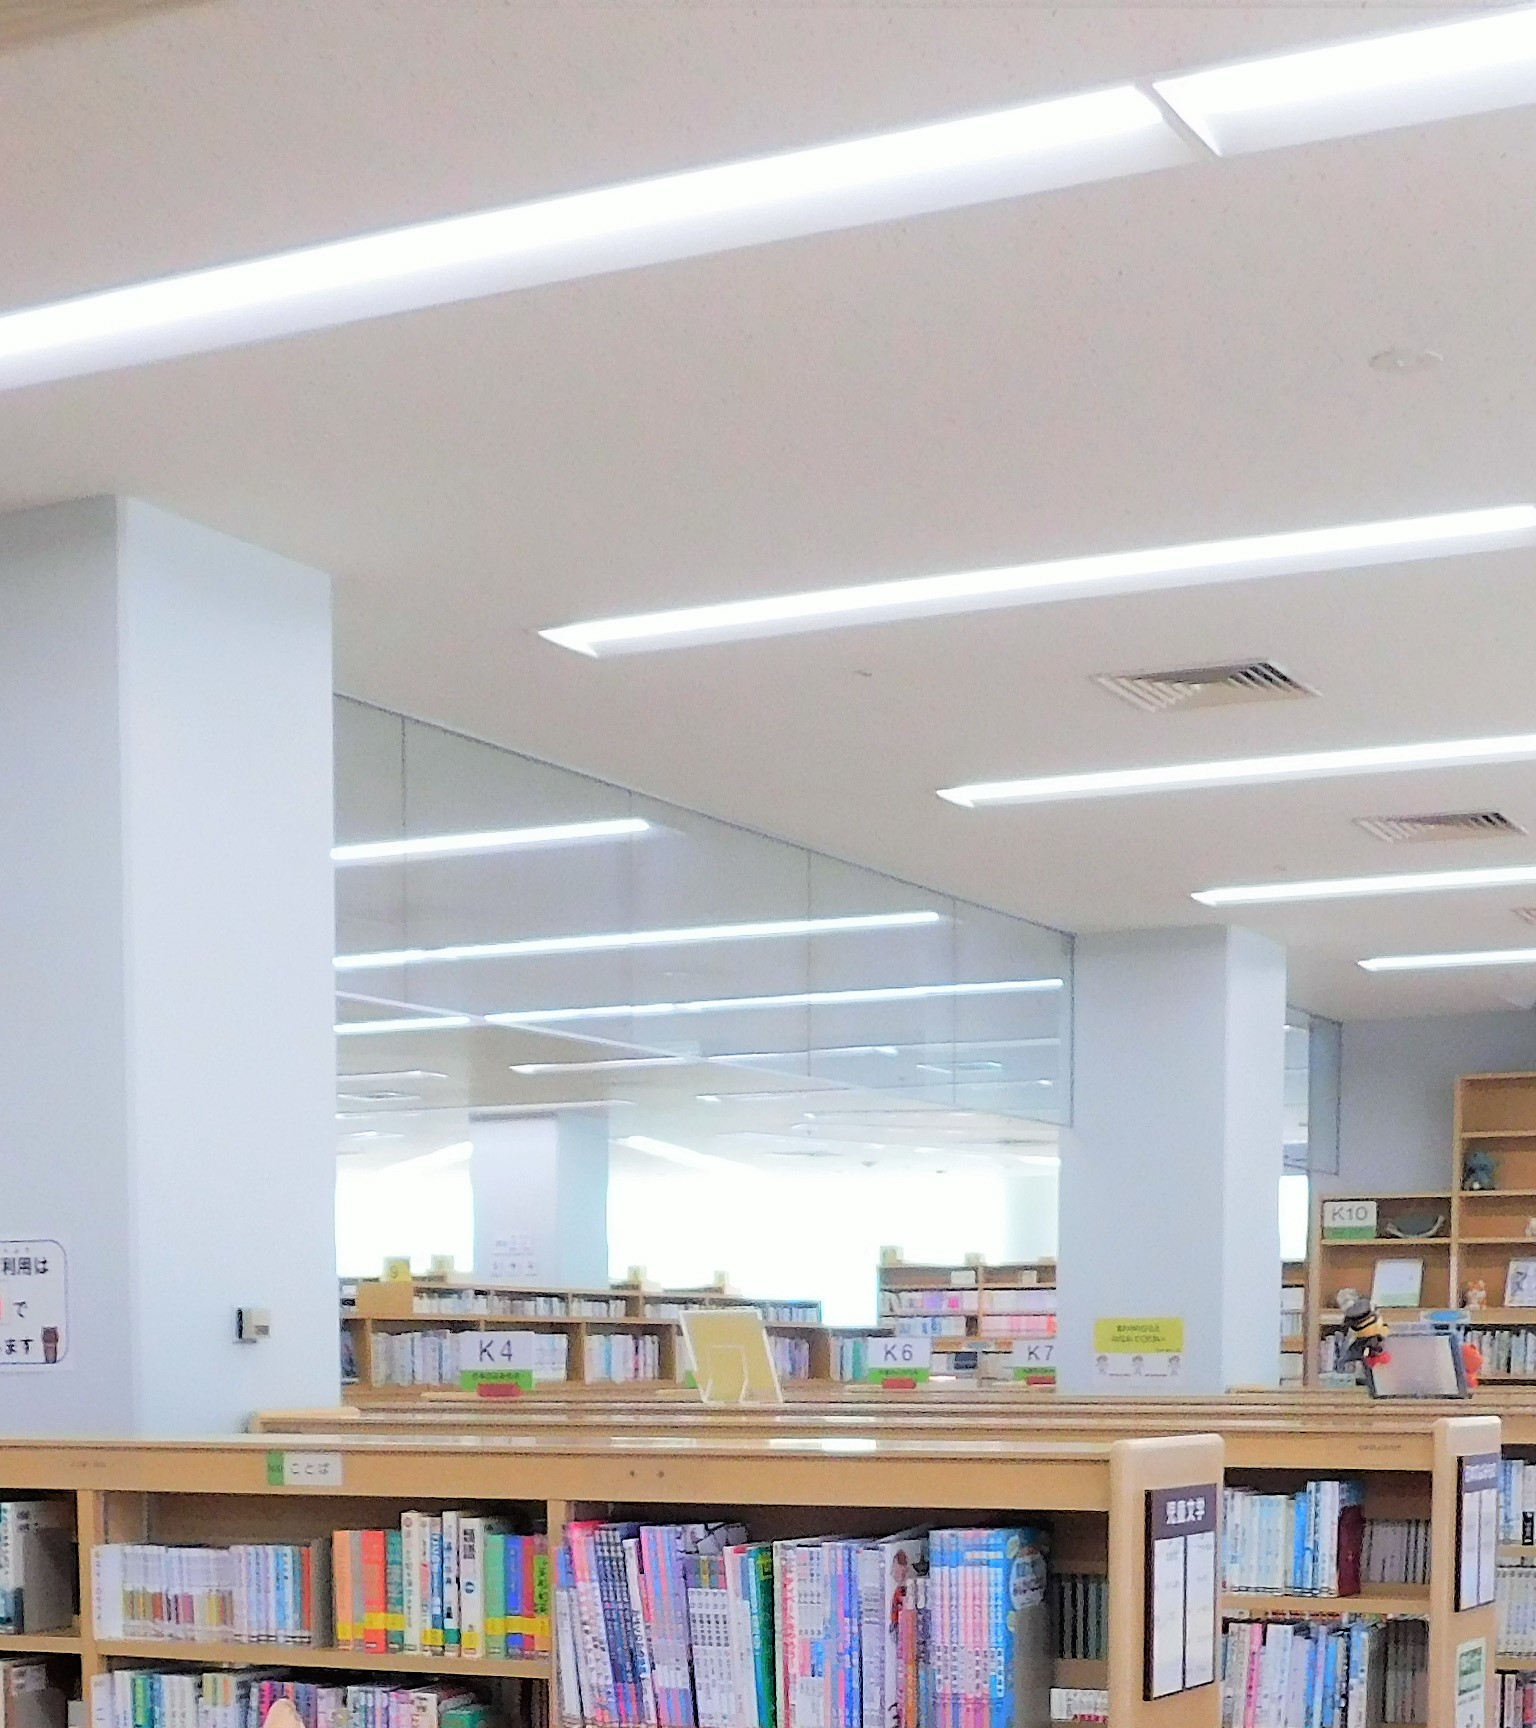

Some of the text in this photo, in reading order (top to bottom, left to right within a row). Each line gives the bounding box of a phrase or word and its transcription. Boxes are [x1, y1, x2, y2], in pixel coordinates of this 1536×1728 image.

[1332, 1206, 1368, 1221] K10
[479, 1339, 514, 1363] K4
[884, 1343, 914, 1362] K6
[1027, 1345, 1055, 1361] K7
